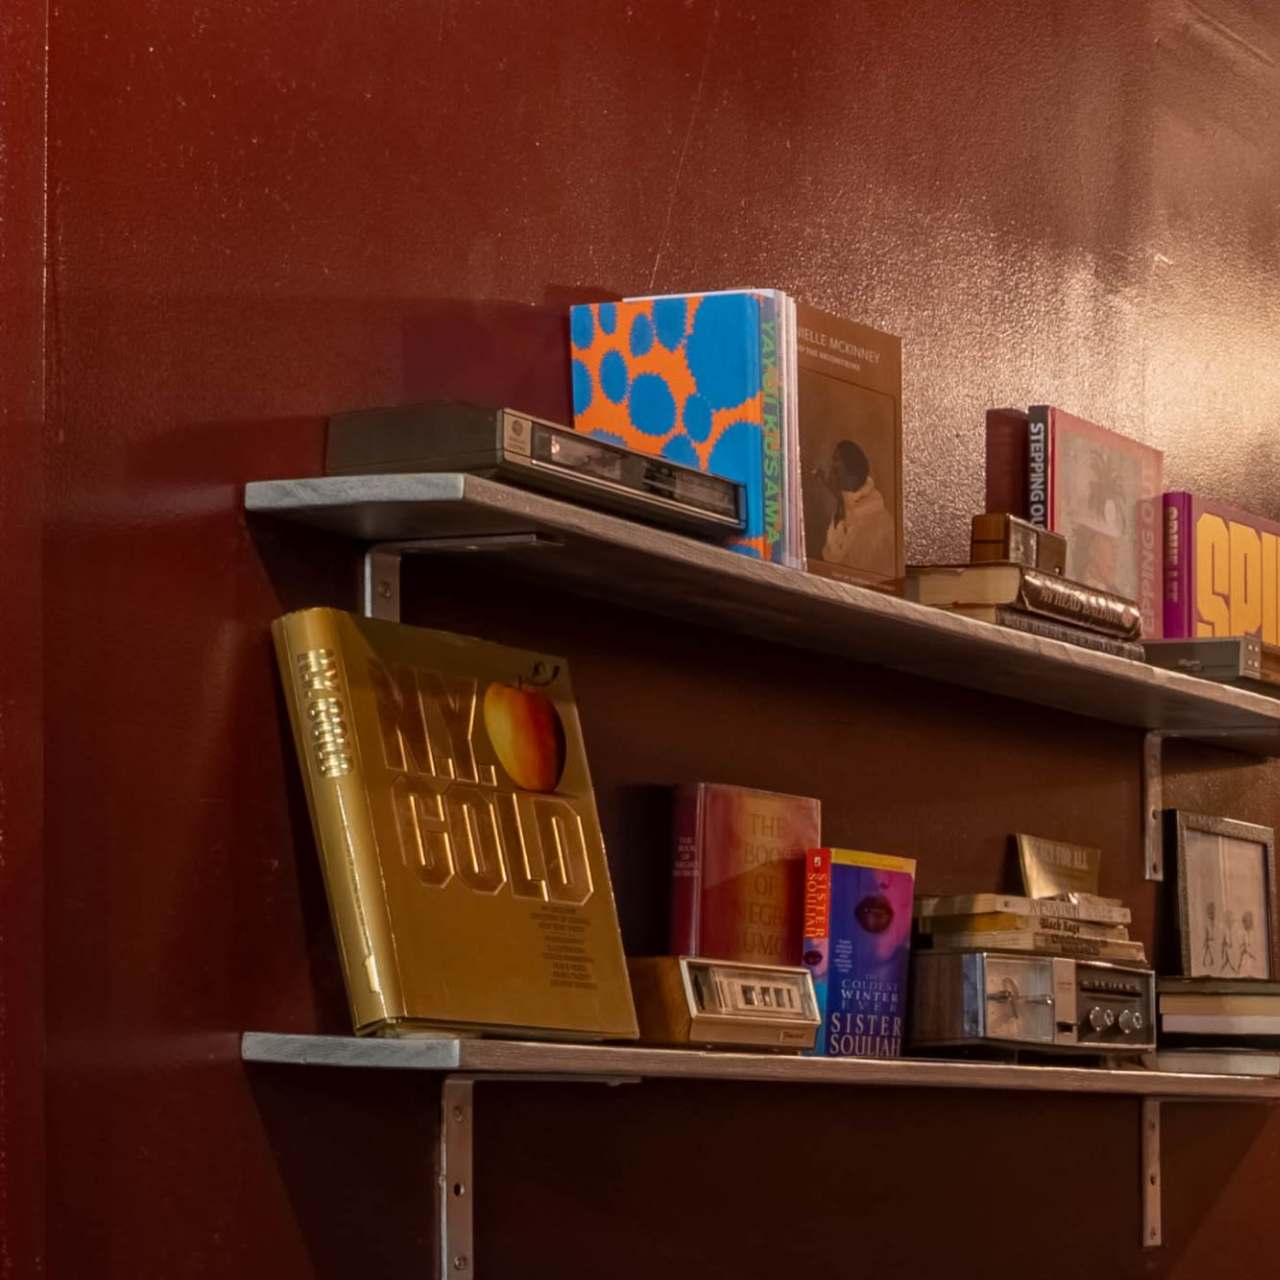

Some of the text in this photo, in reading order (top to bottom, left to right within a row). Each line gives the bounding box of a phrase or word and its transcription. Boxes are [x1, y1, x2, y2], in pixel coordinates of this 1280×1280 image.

[764, 413, 782, 545] KUSAMA
[1030, 422, 1045, 530] STEPPING OU
[1140, 529, 1156, 629] EPPING
[390, 777, 594, 905] GOLD
[751, 813, 788, 839] THE
[815, 872, 827, 938] SISTER
[831, 1012, 902, 1037] SISTER
[841, 988, 899, 1002] WINTER
[830, 1034, 901, 1057] SOULJAH
